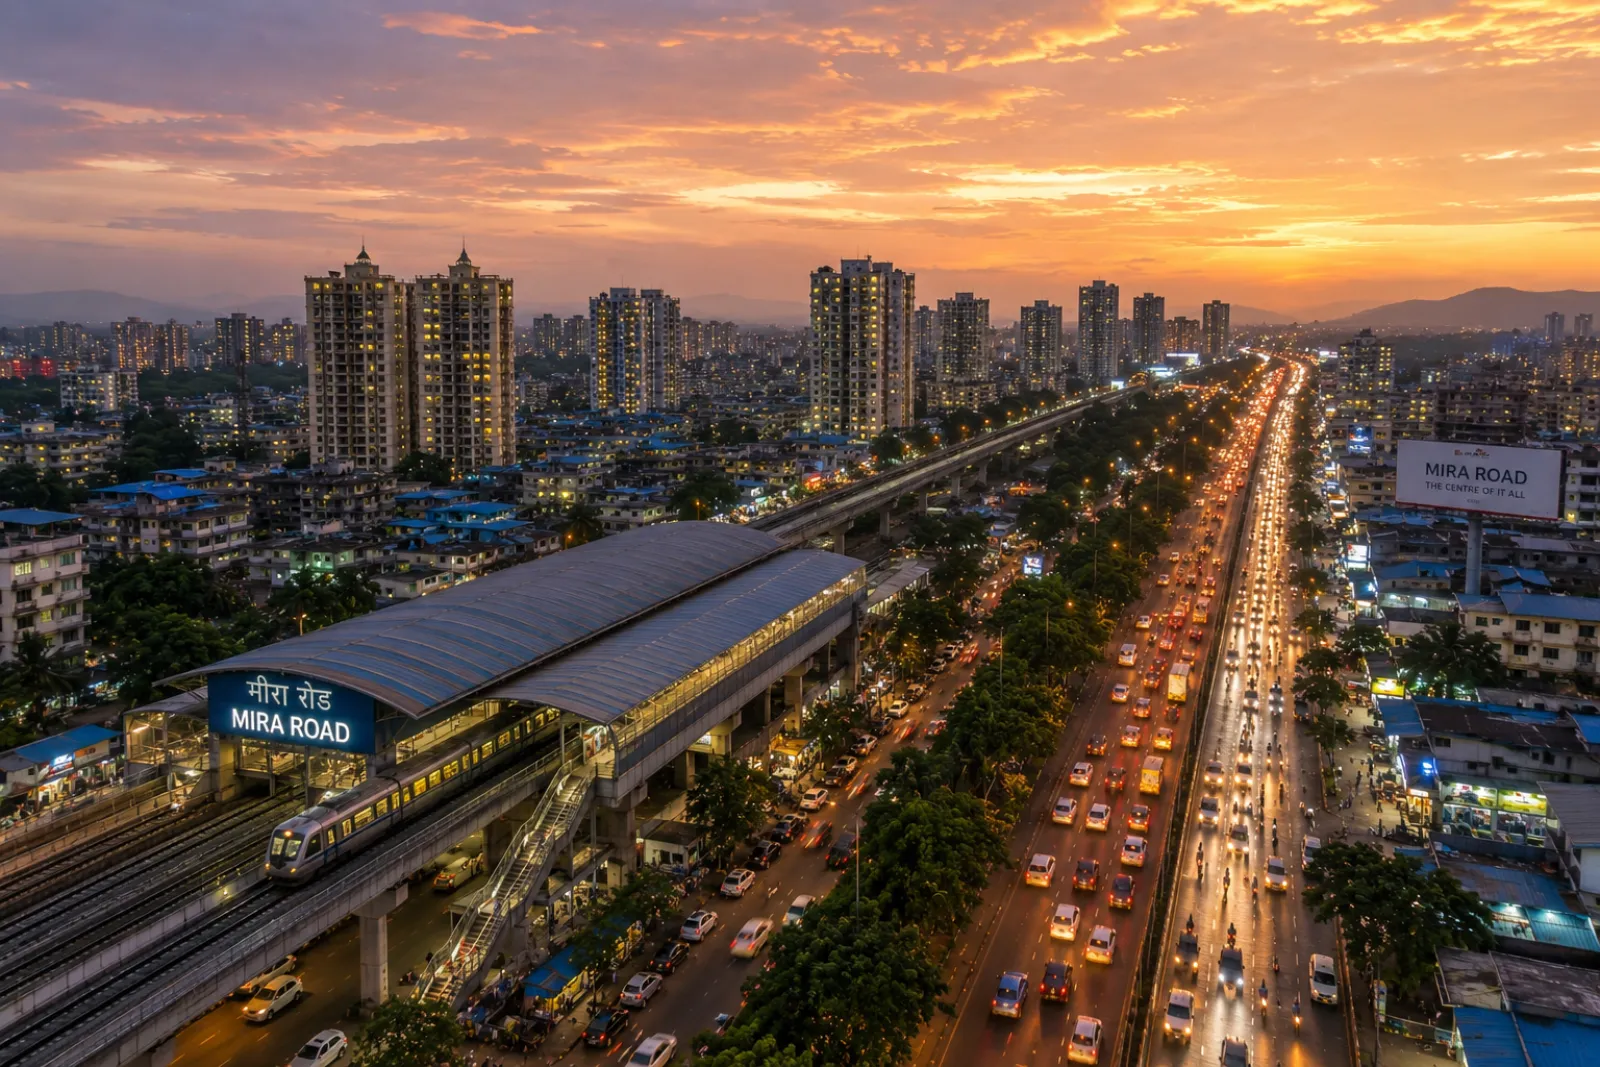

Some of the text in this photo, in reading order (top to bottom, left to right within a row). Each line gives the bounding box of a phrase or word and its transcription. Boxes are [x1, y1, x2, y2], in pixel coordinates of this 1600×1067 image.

[1425, 462, 1528, 485] MIRA ROAD
[1425, 481, 1526, 499] THE CENTRE OF IT ALL
[245, 674, 332, 711] मीरा रोड
[231, 708, 350, 743] MIRA ROAD
